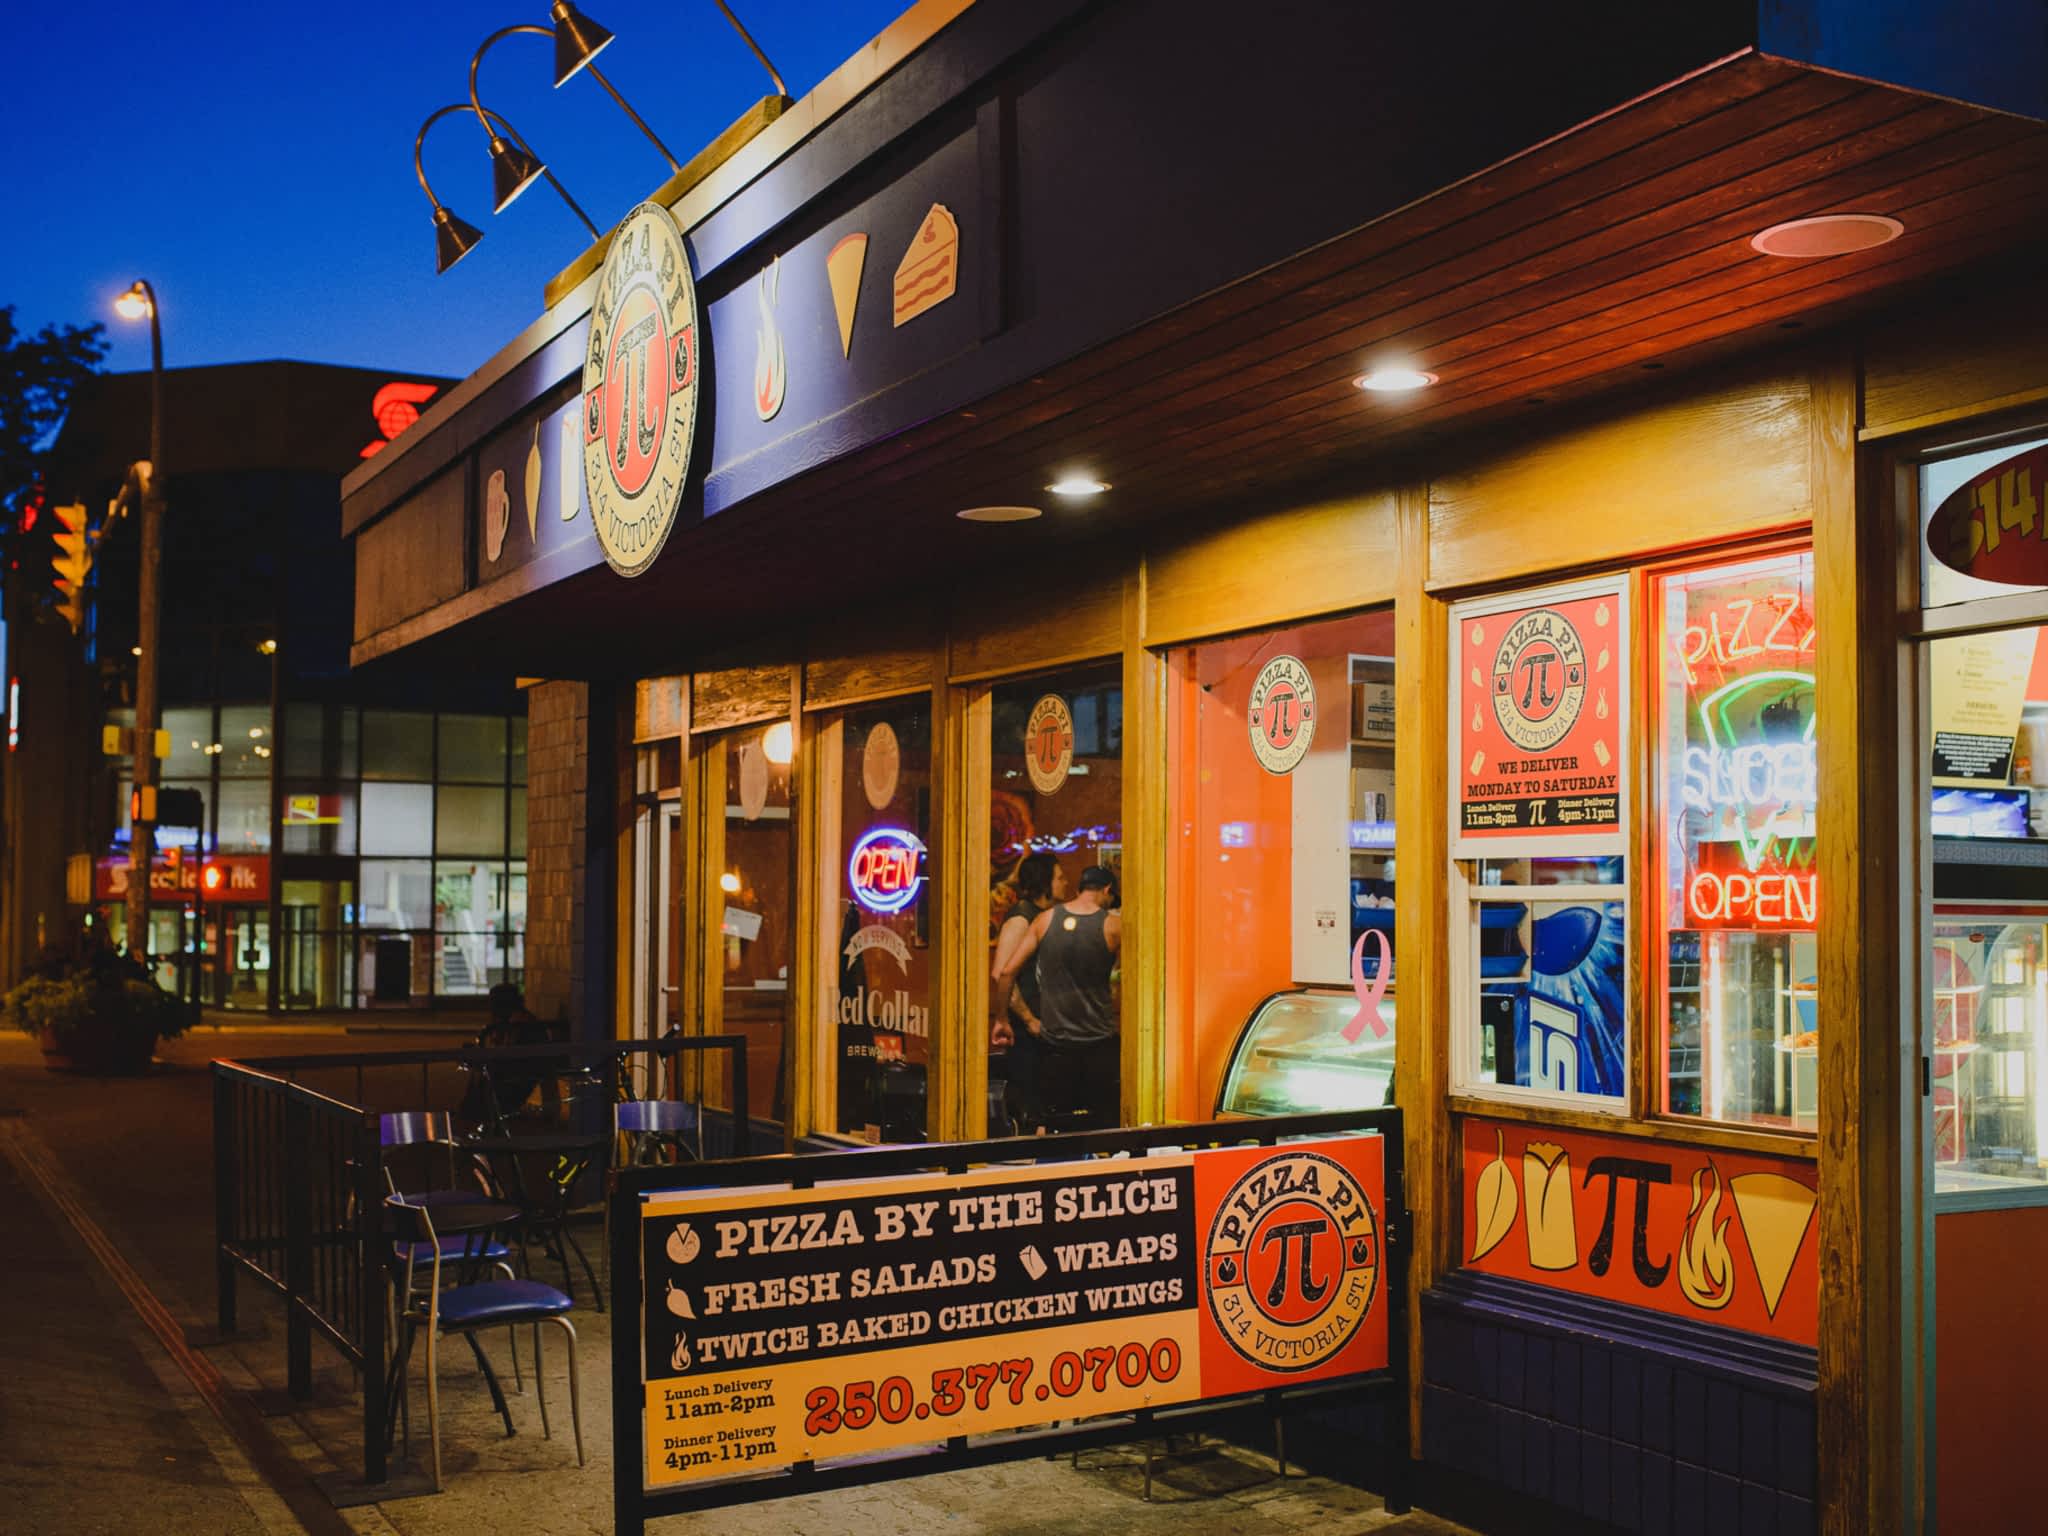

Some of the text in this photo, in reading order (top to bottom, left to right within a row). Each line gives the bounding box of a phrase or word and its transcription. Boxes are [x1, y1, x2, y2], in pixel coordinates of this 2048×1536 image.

[590, 223, 685, 373] PIZZA PI
[588, 458, 609, 521] 314
[608, 473, 674, 555] VICTORIA
[1499, 617, 1578, 670] PIZZA PI
[1676, 593, 1816, 684] PIZZ
[1254, 663, 1310, 706] PIZZA PI
[1515, 716, 1568, 744] VICTORIA
[1468, 775, 1617, 797] MONDAY TO SATURDAY
[1498, 756, 1579, 775] WE DELIVER
[1557, 808, 1616, 824] 4pm-11pm
[855, 847, 918, 889] OPEN
[1690, 871, 1816, 922] OPEN
[715, 1177, 1178, 1259] PIZZA BY THE SLICE
[1220, 1165, 1365, 1247] PIZZA PI
[703, 1232, 1178, 1315] FRESH SALADS WRAPS
[697, 1278, 1184, 1363] TWICE BAKED CHICKEN WINGS
[1223, 1274, 1369, 1360] 314 VICTORIA ST.
[664, 1379, 773, 1400] Lunch Delivery
[664, 1392, 776, 1422] 11am-2pm
[804, 1337, 1182, 1438] 250.377.0700
[664, 1425, 777, 1450] Dinner Delivery
[664, 1440, 777, 1471] 4pm-11pm
